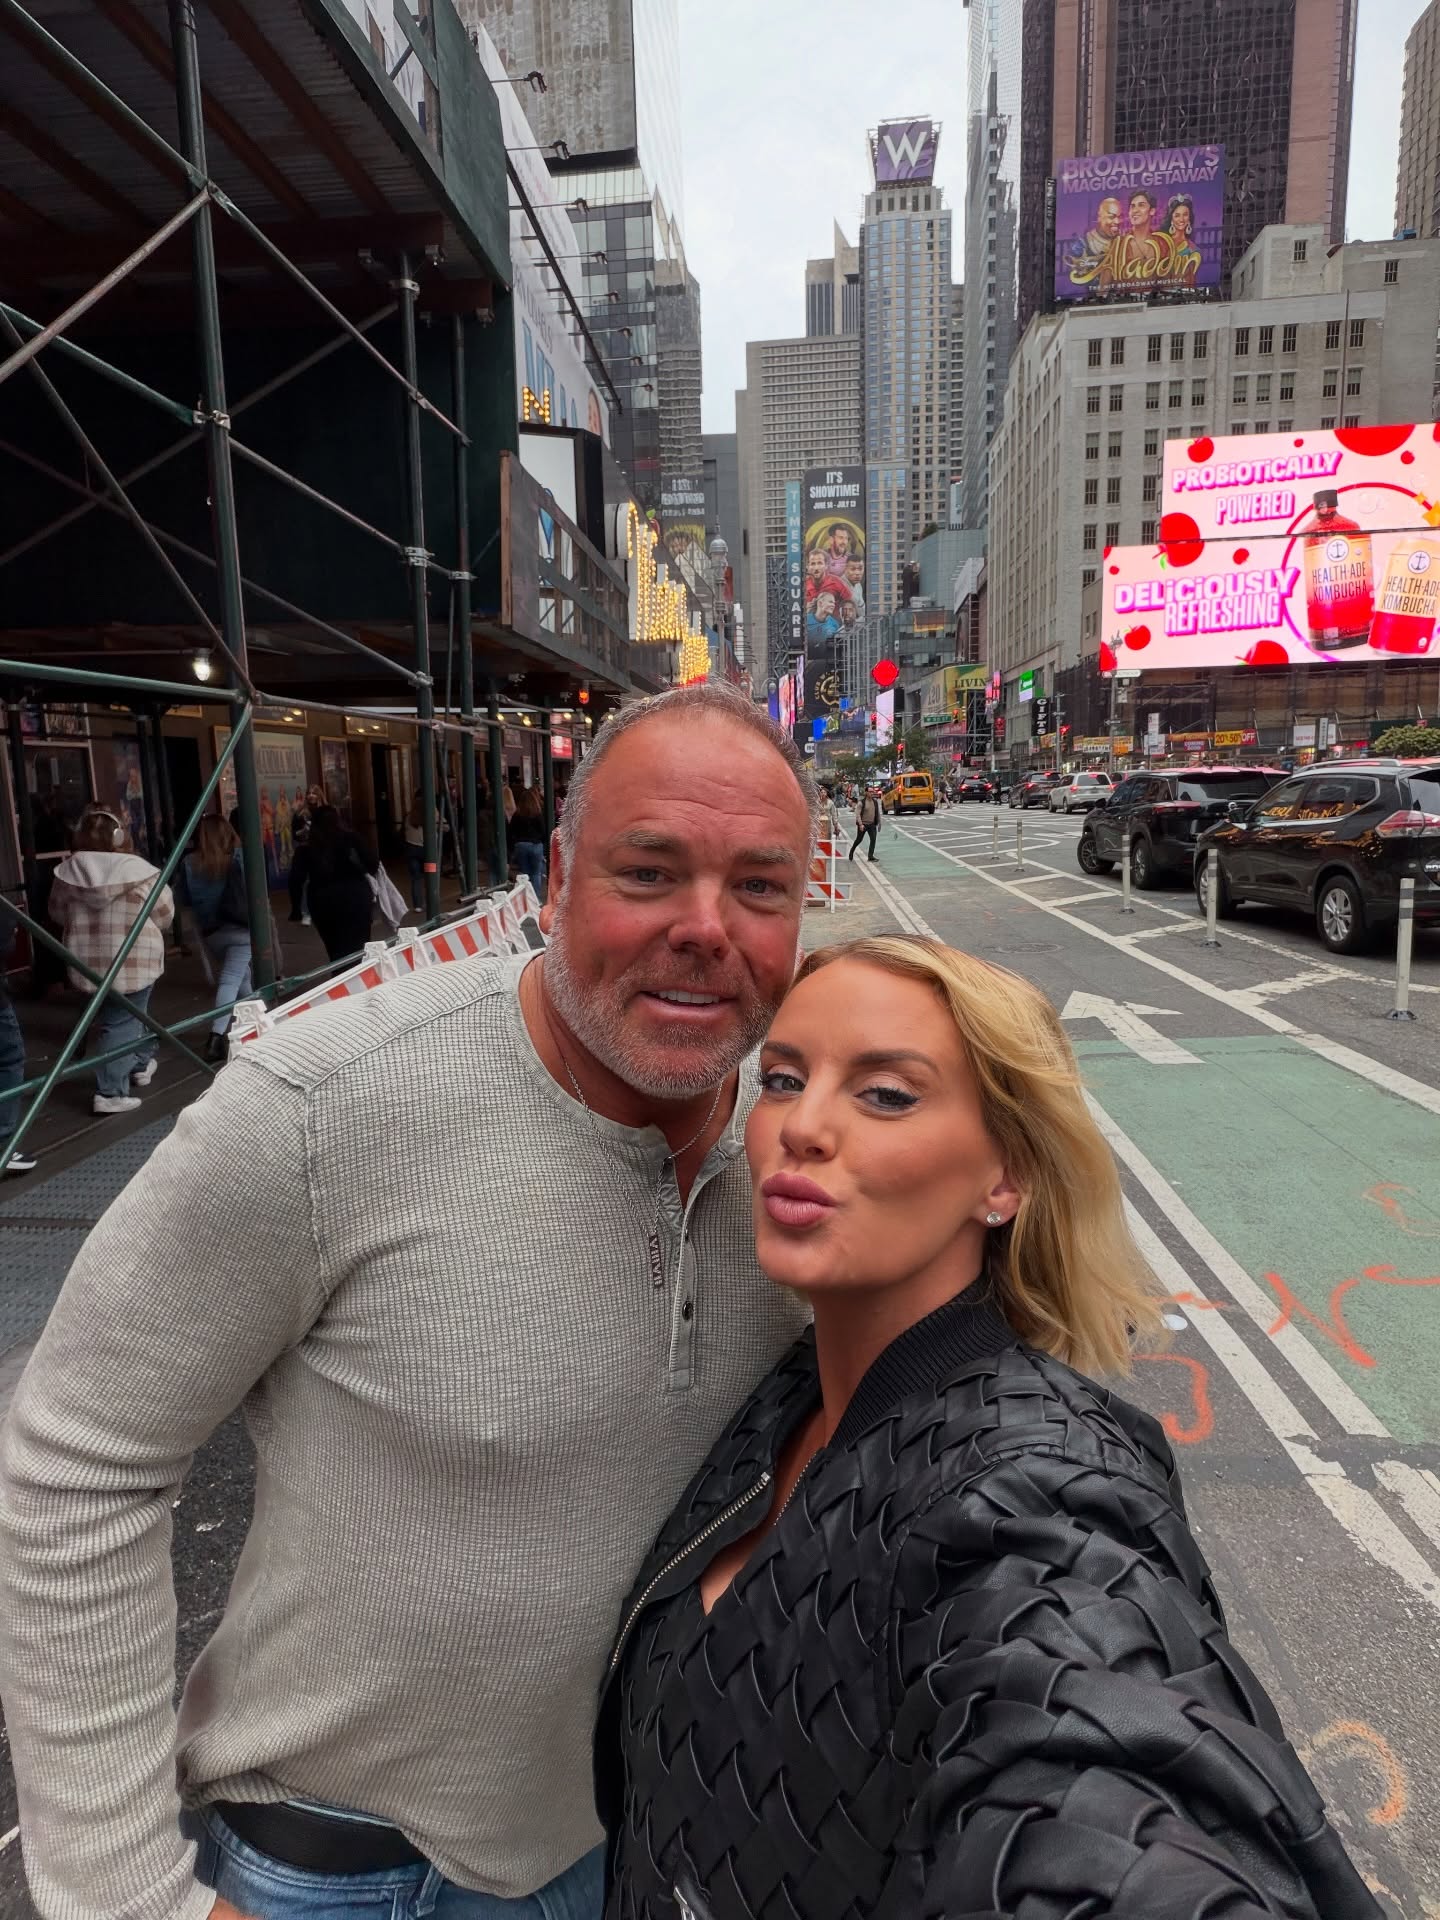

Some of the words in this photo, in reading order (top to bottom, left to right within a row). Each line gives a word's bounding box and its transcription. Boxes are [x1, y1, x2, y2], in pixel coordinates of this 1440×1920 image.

[882, 131, 928, 170] W
[1063, 146, 1220, 179] BROADWAY'S
[1063, 176, 1138, 194] MAGICAL
[1141, 166, 1218, 186] GETAWAY
[1069, 231, 1202, 285] Aladdin
[521, 386, 551, 424] N
[809, 483, 860, 498] SHOWTIME!
[826, 471, 843, 484] IT'S
[789, 490, 801, 553] TIMES
[1215, 489, 1295, 525] POWERED
[790, 562, 801, 638] SQUARE
[1313, 580, 1367, 602] KOMBUCHA
[1382, 594, 1435, 616] KOMBUCHA
[1164, 591, 1286, 636] REFRESHING
[1036, 698, 1047, 735] GIFTS
